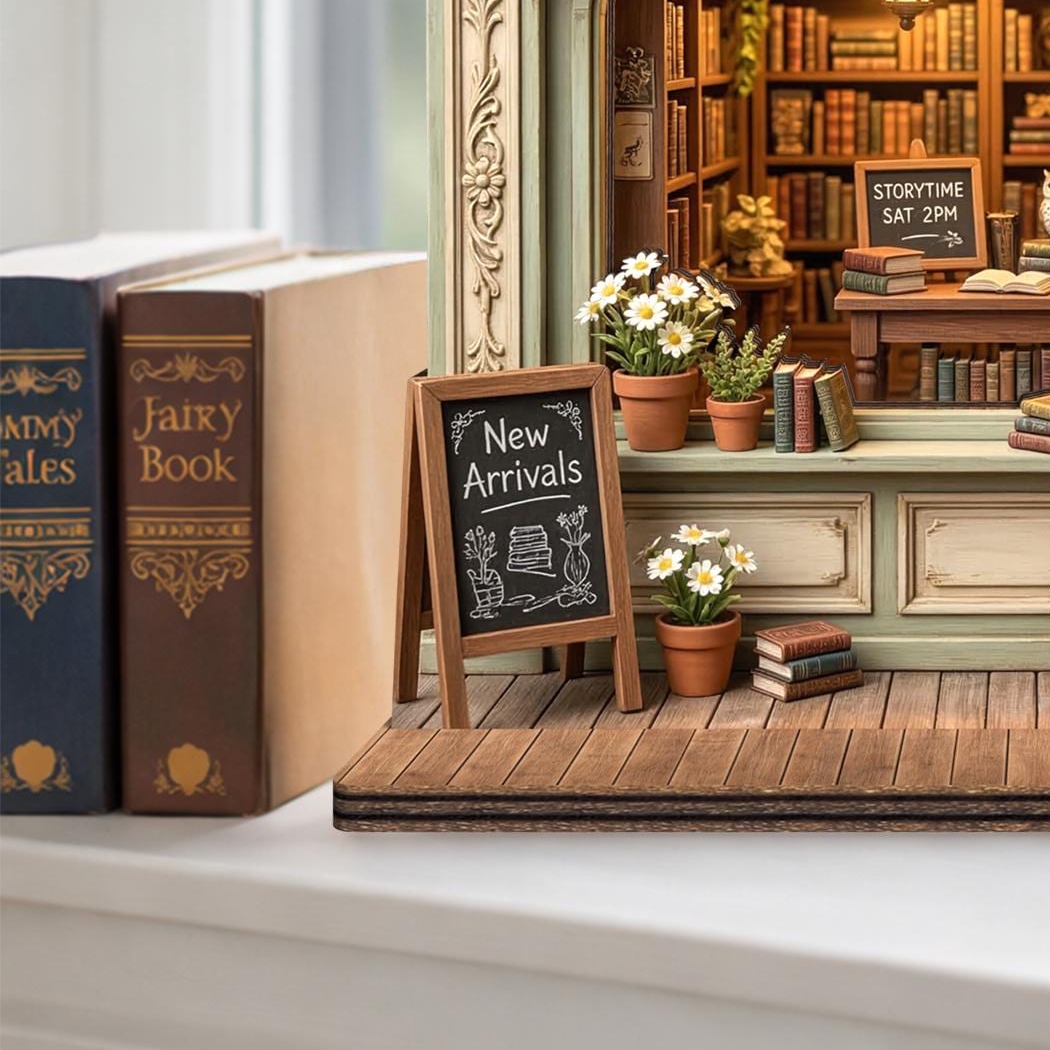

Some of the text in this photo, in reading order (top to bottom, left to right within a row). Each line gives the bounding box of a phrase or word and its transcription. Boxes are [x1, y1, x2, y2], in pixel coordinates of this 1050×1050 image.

[873, 181, 965, 200] STORYTIME
[882, 205, 958, 224] SAT 2PM
[483, 417, 550, 454] New
[0, 448, 78, 485] ales
[138, 444, 238, 483] Book
[463, 450, 583, 499] Arrivals
